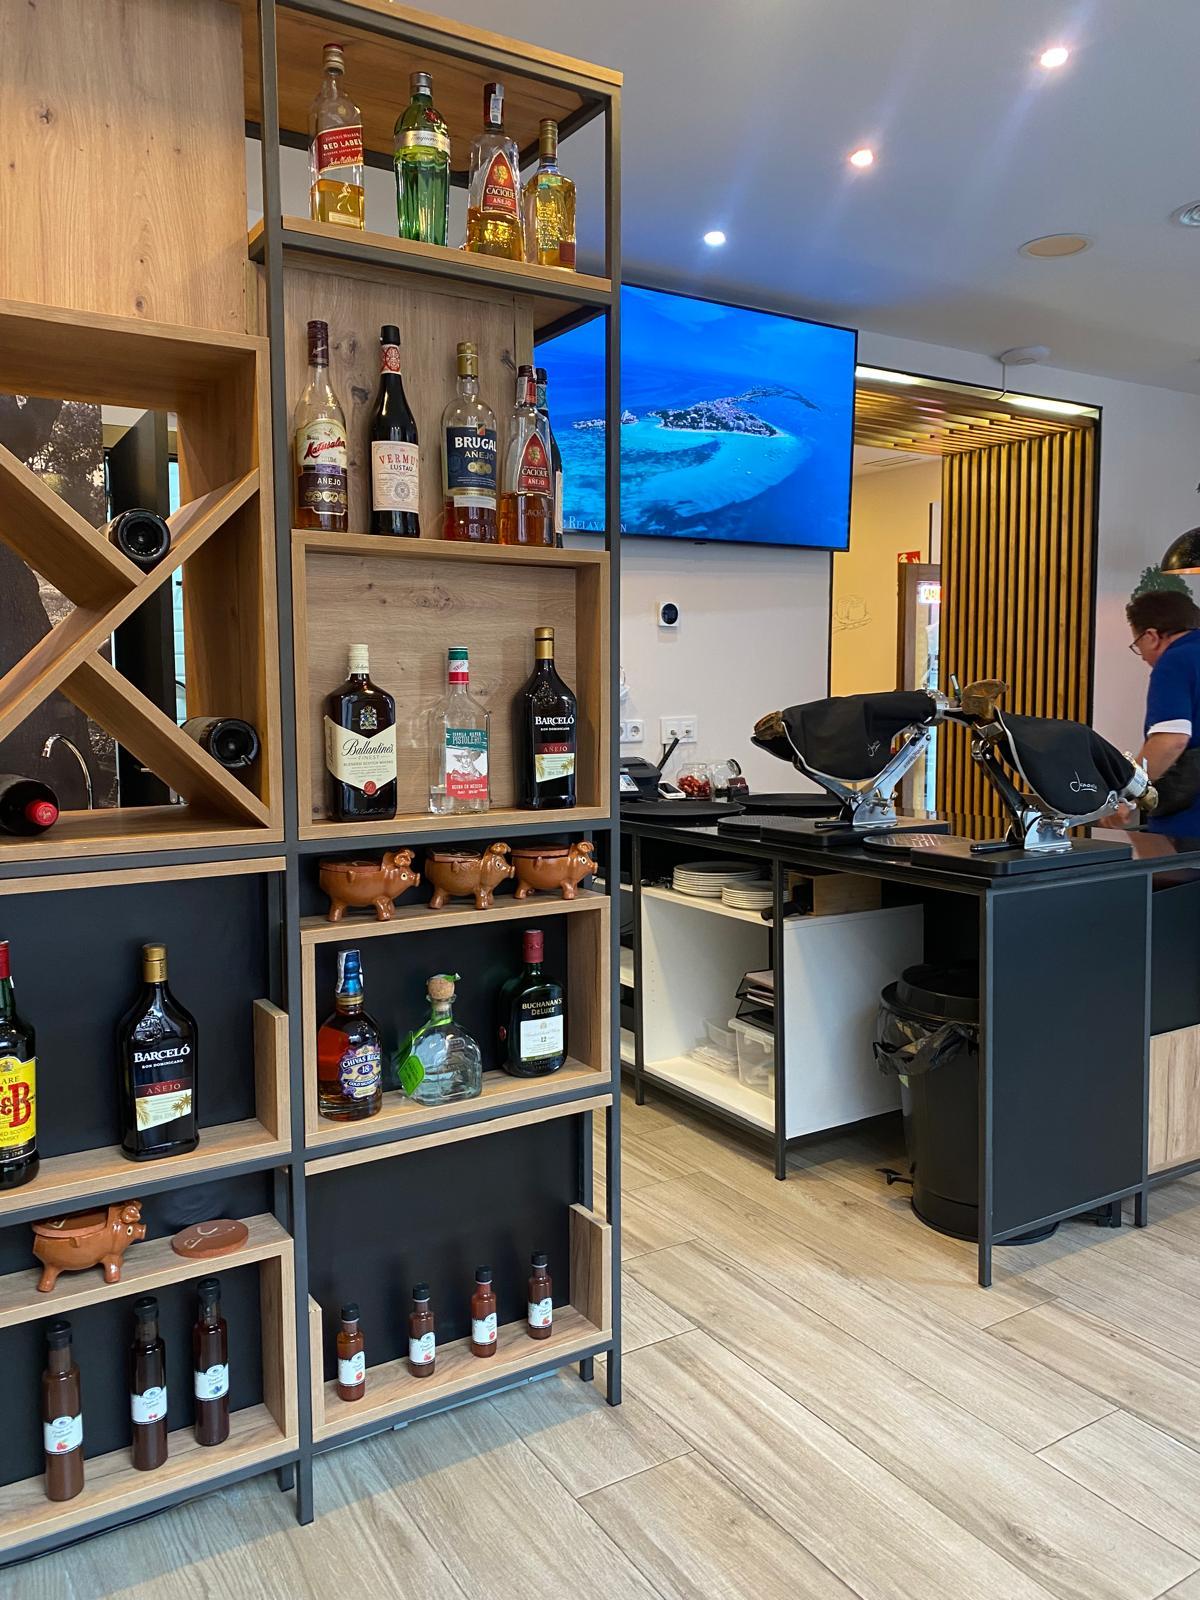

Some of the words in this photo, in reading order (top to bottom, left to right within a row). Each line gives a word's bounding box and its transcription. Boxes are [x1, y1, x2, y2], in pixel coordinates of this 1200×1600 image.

[322, 142, 339, 151] RED
[340, 138, 363, 147] LABEL
[486, 187, 516, 199] CACIQUE
[454, 436, 497, 452] BRUGAL
[464, 450, 494, 460] AÑEJO
[390, 464, 413, 472] LUSTAU
[521, 468, 548, 477] CACIQUE
[317, 476, 342, 486] AÑEJO
[528, 478, 545, 486] AÑEJO
[535, 714, 575, 726] BARCELÓ
[452, 735, 482, 745] PISTOLERO
[341, 738, 394, 756] Ballantine's
[543, 745, 568, 753] AÑEJO
[134, 1043, 191, 1063] BARCELÓ
[153, 1058, 184, 1068] DOMINICANO
[342, 1056, 367, 1068] CHIVAS
[362, 1064, 370, 1074] 18
[146, 1083, 181, 1095] AÑEJO
